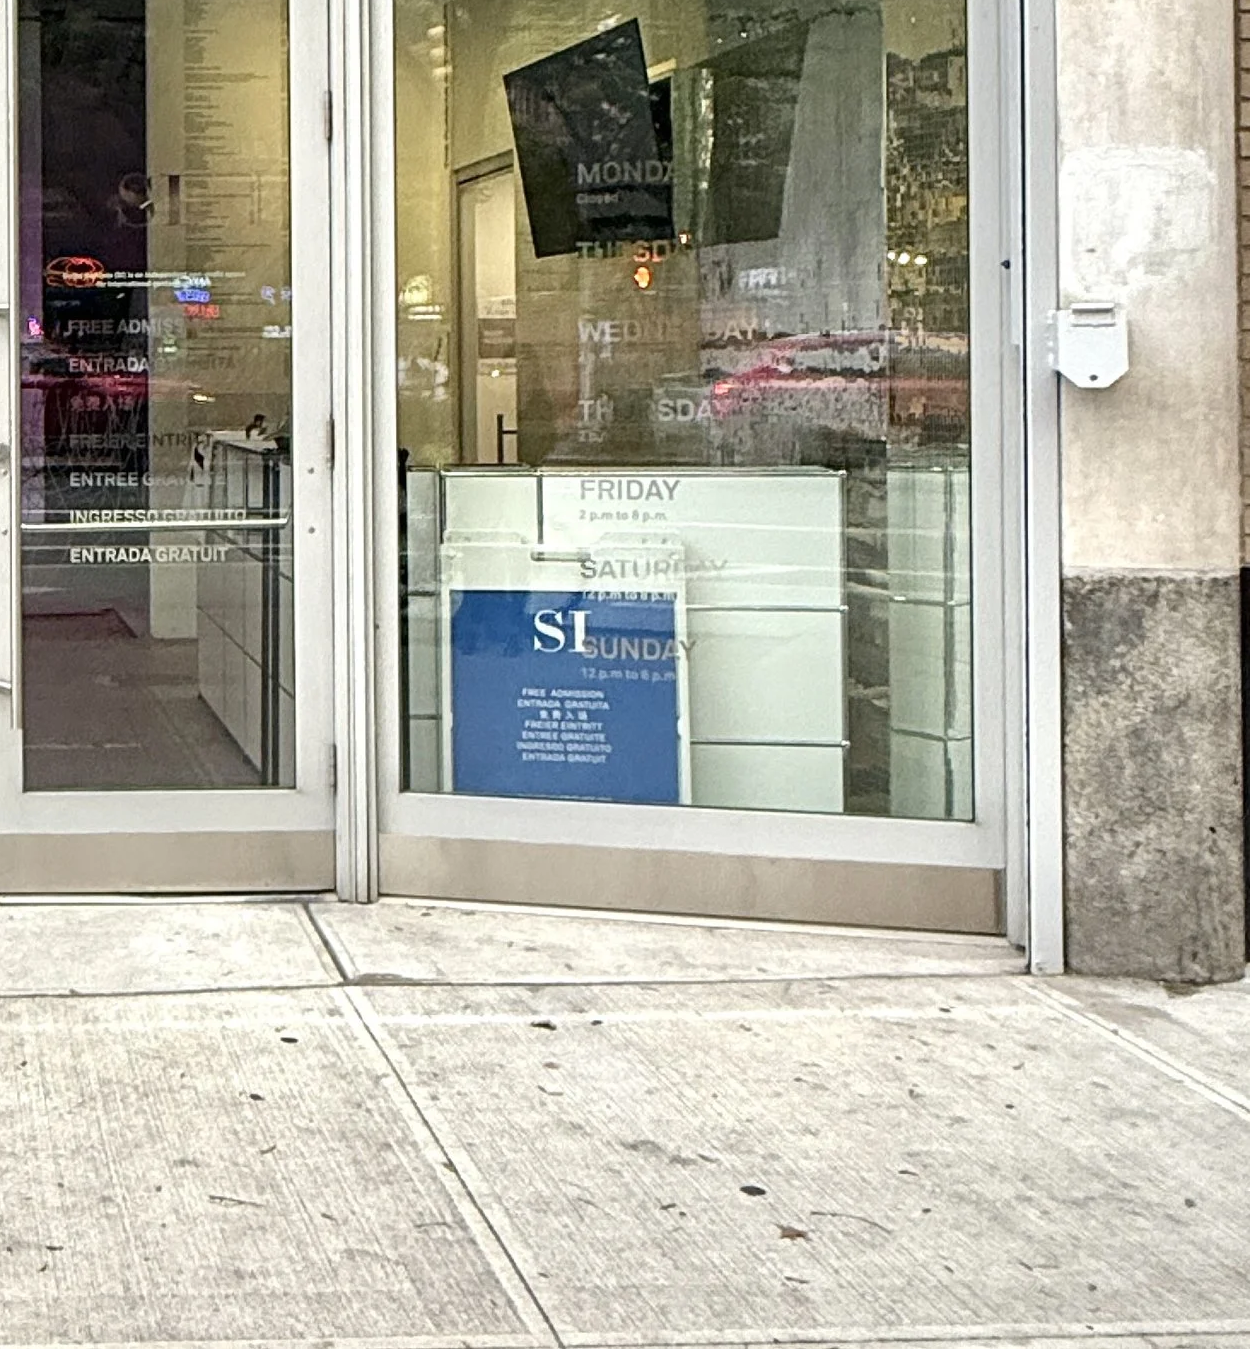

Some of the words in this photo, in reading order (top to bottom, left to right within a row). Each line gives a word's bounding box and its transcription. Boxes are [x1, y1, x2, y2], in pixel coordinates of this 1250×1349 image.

[579, 479, 681, 501] FRIDAY
[69, 546, 152, 564] ENTRADA
[154, 546, 230, 564] GRATUIT
[533, 608, 593, 653] SI
[582, 636, 697, 662] SUNDAY
